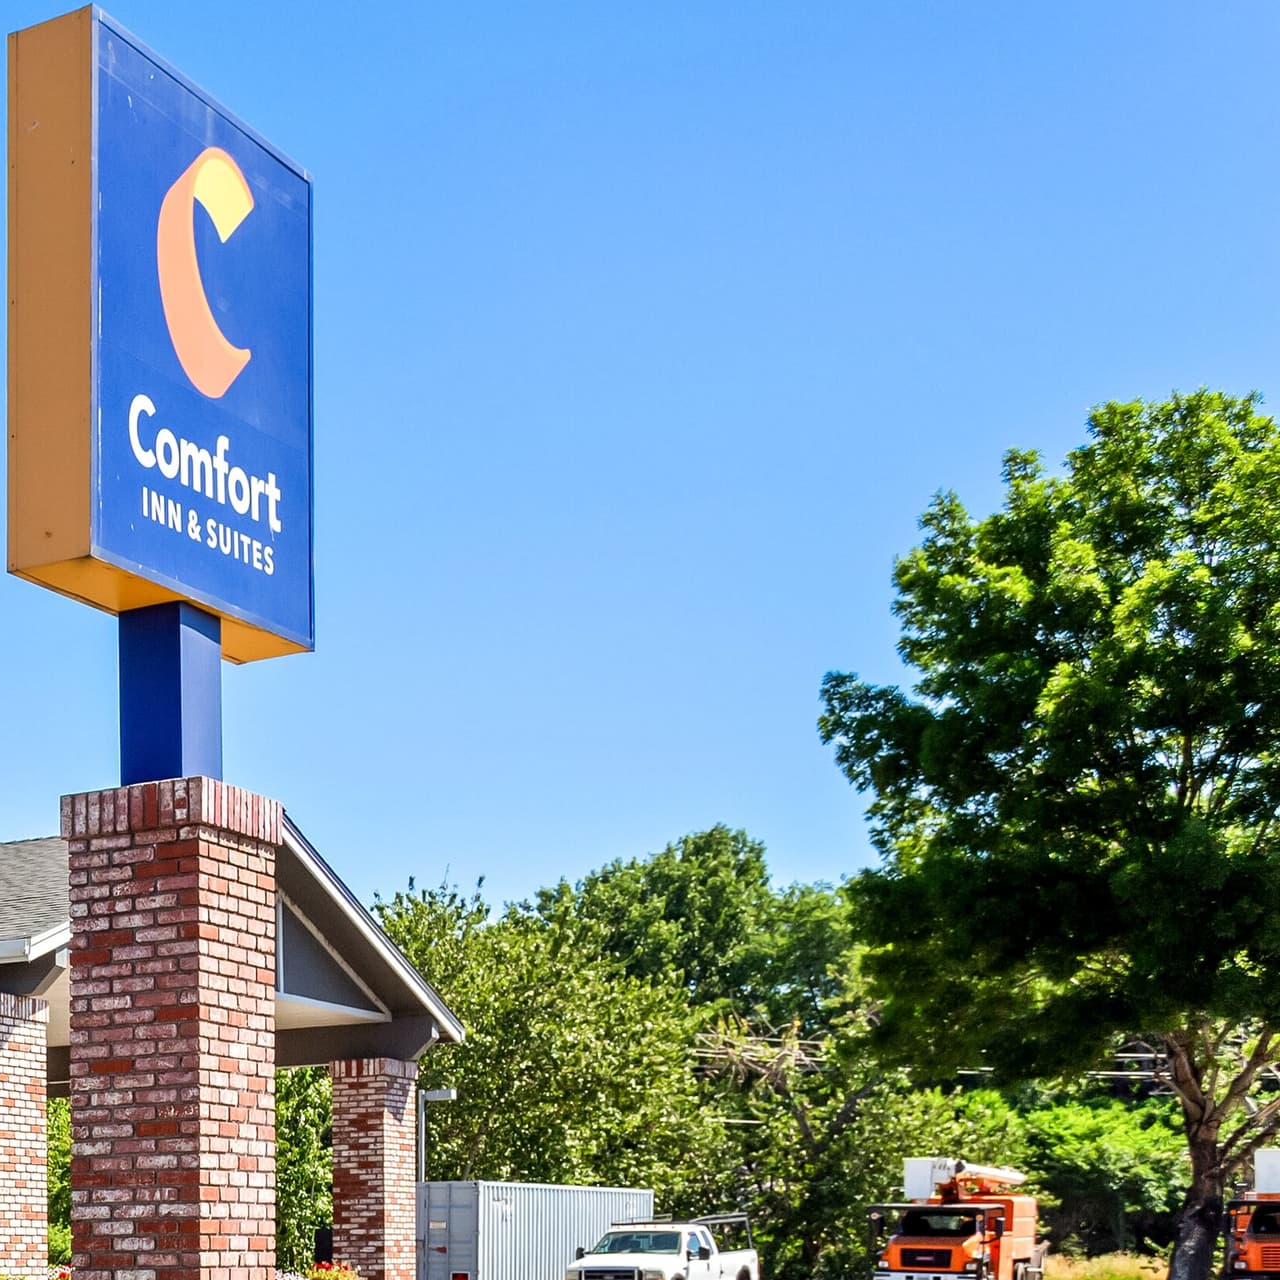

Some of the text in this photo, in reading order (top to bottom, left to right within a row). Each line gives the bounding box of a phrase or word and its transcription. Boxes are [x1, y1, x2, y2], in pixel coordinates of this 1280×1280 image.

[128, 394, 281, 533] Comfort
[142, 486, 274, 575] INN & SUITES
